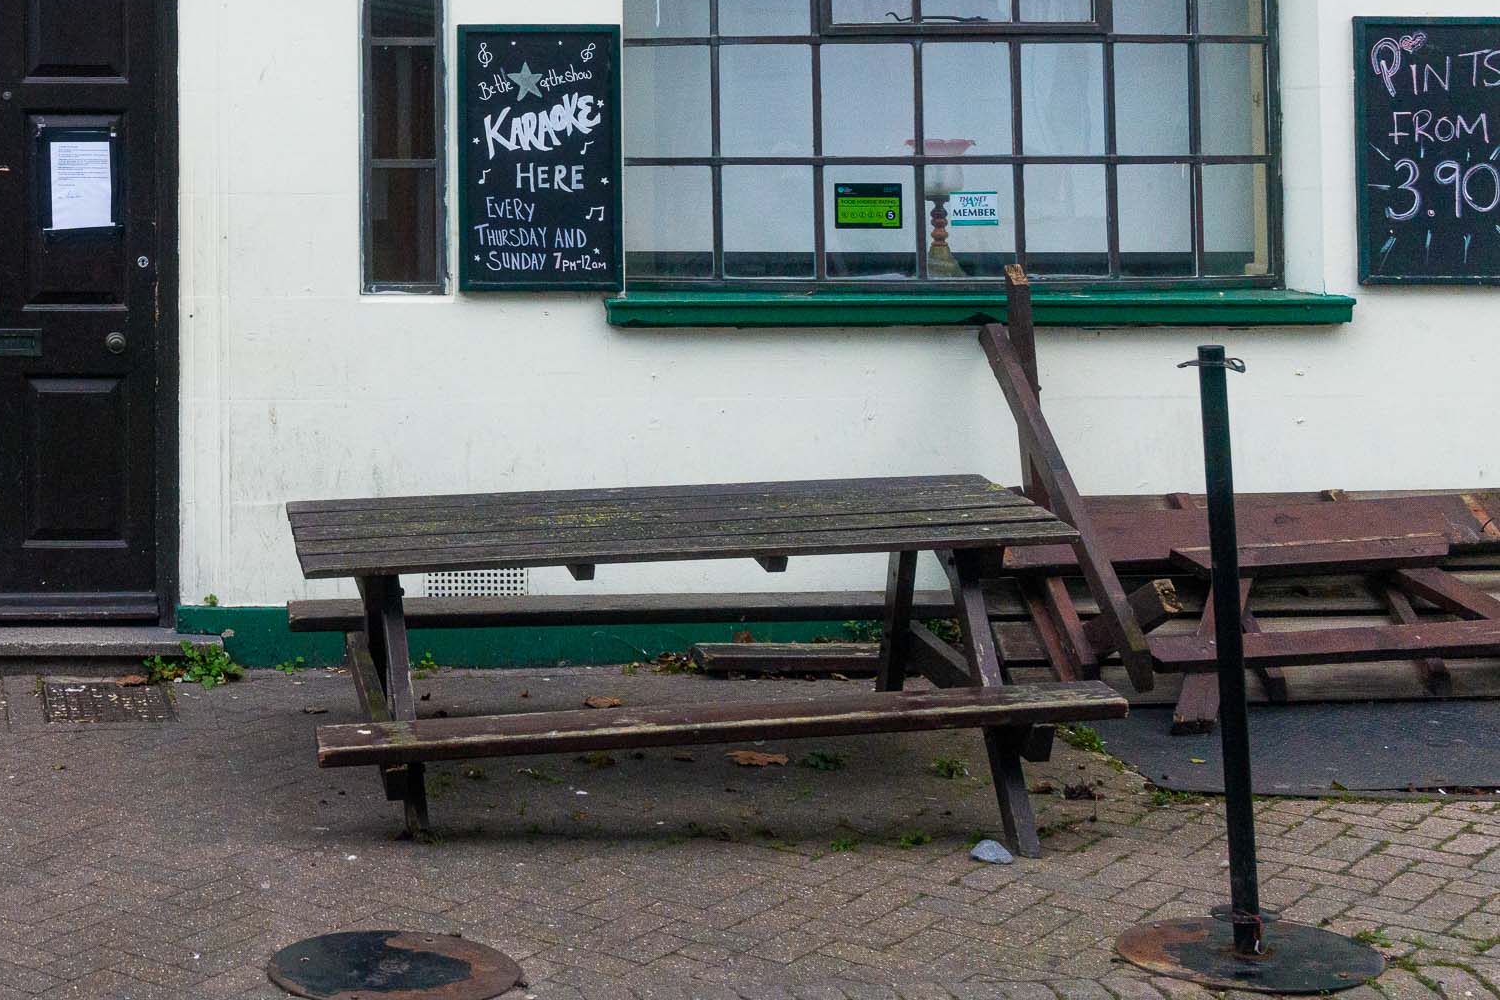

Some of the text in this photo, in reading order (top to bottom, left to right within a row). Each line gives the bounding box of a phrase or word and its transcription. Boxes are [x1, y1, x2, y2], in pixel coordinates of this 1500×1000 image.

[478, 81, 497, 100] Be
[483, 92, 602, 160] KARAOKE
[1388, 109, 1489, 144] FROM
[516, 163, 584, 192] HERE
[486, 197, 535, 222] EVERY
[474, 224, 587, 249] THURSDAY AND
[486, 251, 547, 271] SUNDAY
